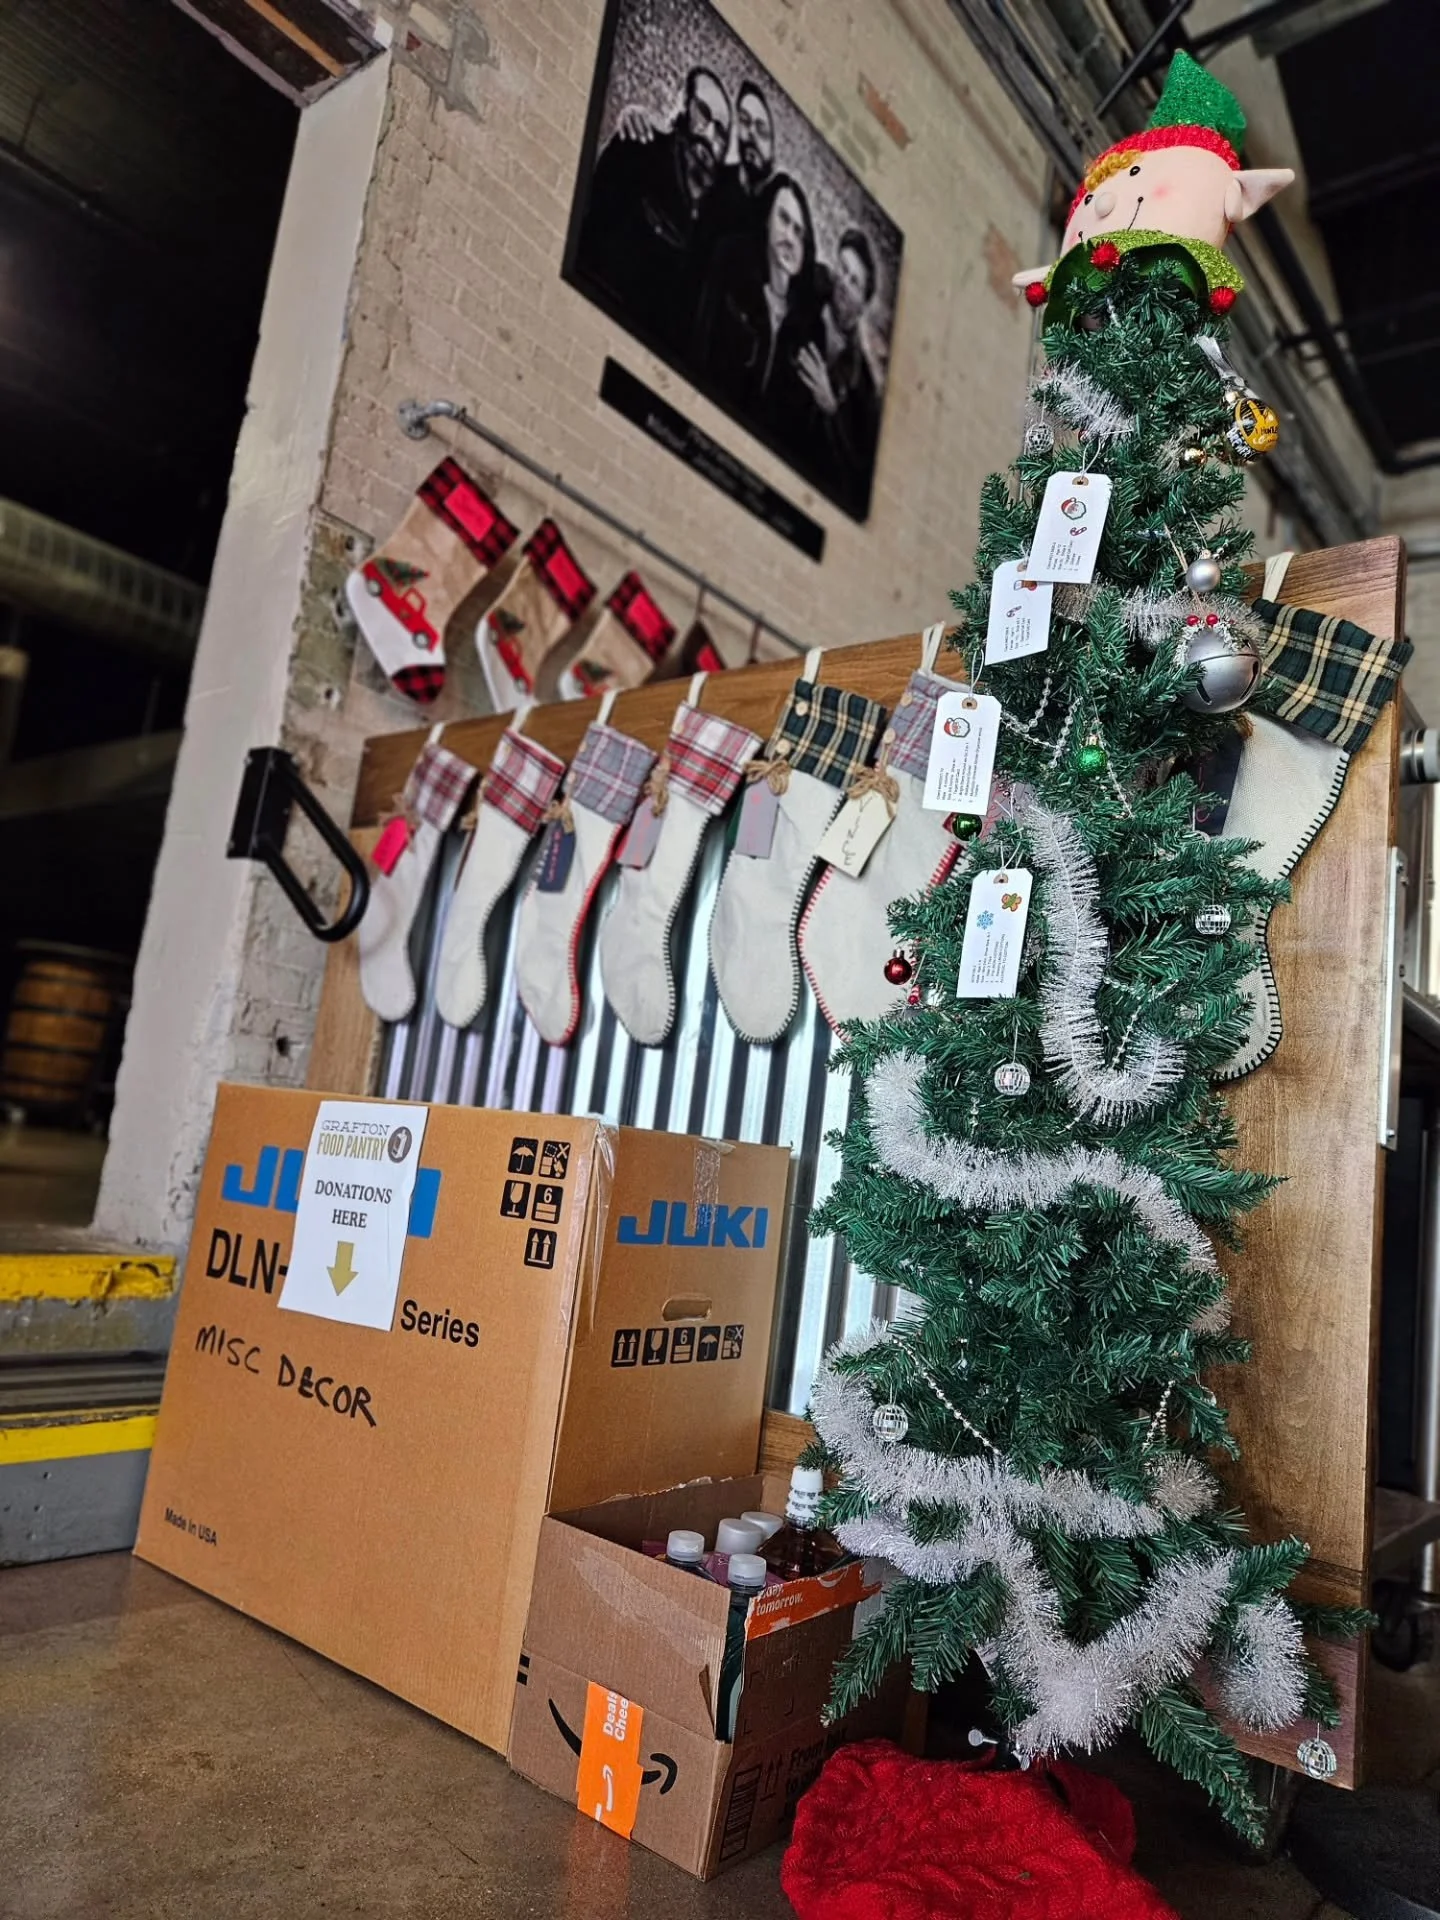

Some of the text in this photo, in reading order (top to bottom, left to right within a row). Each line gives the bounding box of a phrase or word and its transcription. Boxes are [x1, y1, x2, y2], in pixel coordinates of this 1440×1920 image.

[321, 1120, 390, 1136] GRAFTON
[317, 1132, 388, 1161] FOOD PANTRY
[221, 1145, 442, 1239] JI
[315, 1179, 392, 1204] DONATIONS
[332, 1208, 367, 1228] HERE
[617, 1199, 769, 1248] JUKI
[400, 1299, 480, 1347] Series
[195, 1324, 377, 1427] MISC DECOR
[165, 1507, 186, 1531] Made
[198, 1524, 217, 1546] USA
[757, 1592, 803, 1616] tomorrow.
